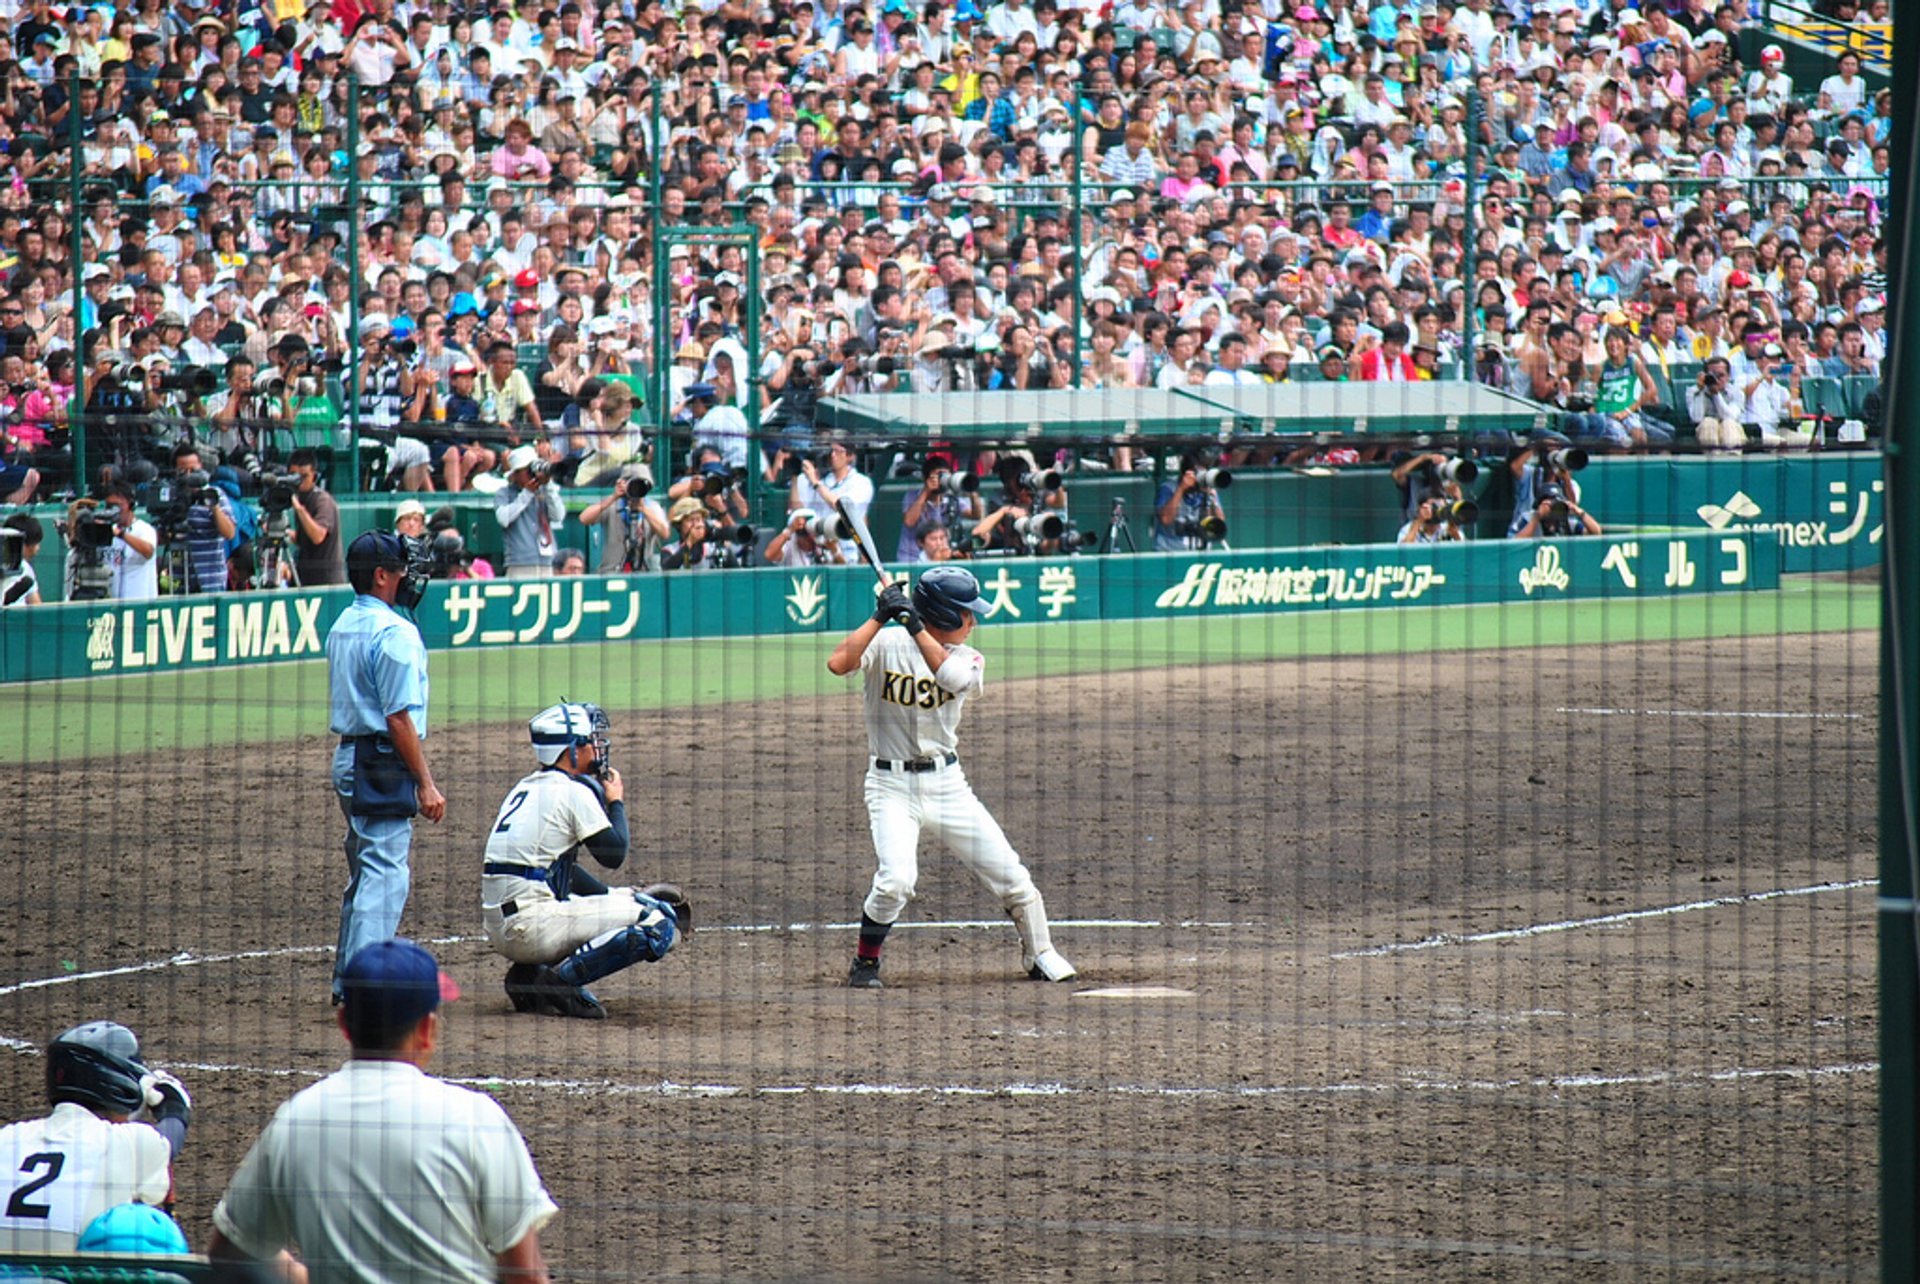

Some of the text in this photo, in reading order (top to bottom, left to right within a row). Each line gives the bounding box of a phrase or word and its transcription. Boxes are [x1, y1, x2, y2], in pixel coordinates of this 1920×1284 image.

[1601, 540, 1747, 588] ベルコ
[226, 597, 322, 660] MAX
[443, 579, 640, 646] サニクリーン
[495, 790, 529, 834] 2
[5, 1152, 65, 1219] 2
